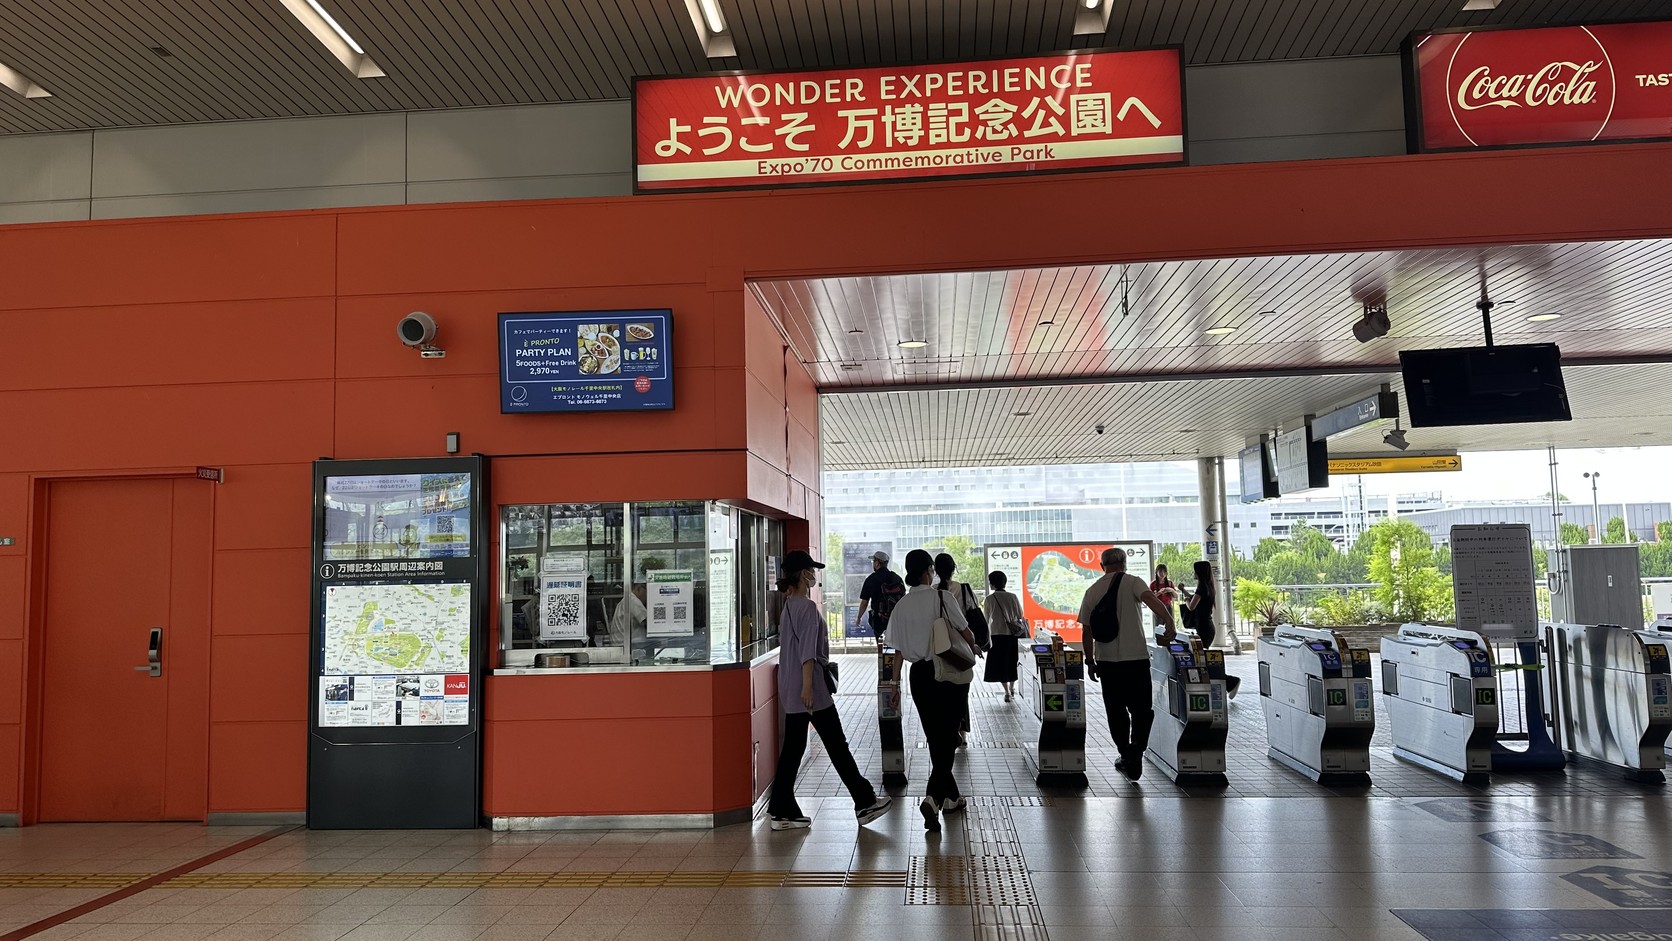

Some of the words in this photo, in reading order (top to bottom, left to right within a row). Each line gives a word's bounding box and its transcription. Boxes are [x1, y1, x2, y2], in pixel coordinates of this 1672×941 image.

[715, 77, 867, 109] WONDER
[880, 63, 1093, 100] EXPERIENCE
[1457, 60, 1604, 110] Coca-Cola
[654, 111, 816, 158] ようこそ
[837, 91, 1163, 151] 万博記念公園へ
[840, 149, 1004, 172] Commemorative
[1010, 143, 1056, 161] Park
[530, 337, 560, 346] PRONTO
[516, 348, 546, 357] PARTY
[547, 348, 572, 356] PLAN
[1357, 403, 1369, 416] 入口
[337, 561, 443, 573] 万博記念公園駅周辺案内図
[1469, 652, 1487, 663] IC
[1192, 696, 1206, 710] IC
[1329, 691, 1343, 705] IC
[1478, 690, 1492, 704] IC
